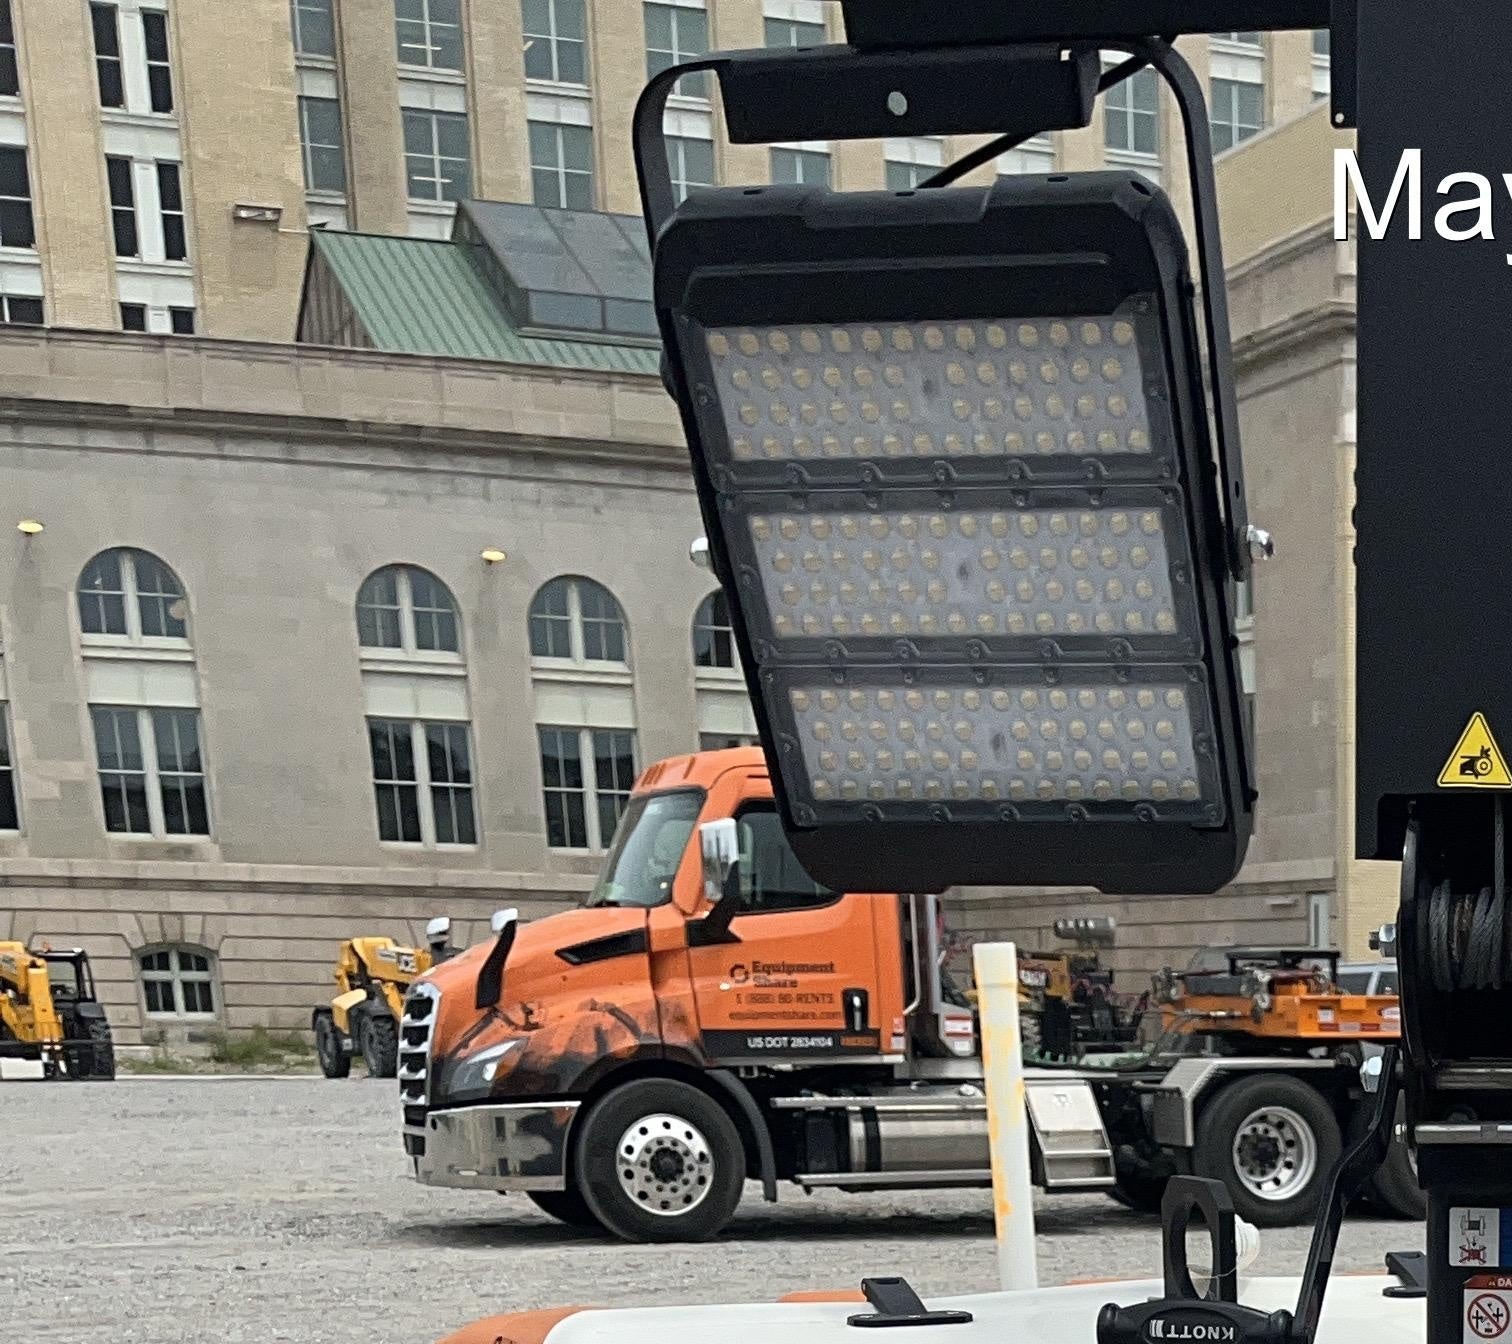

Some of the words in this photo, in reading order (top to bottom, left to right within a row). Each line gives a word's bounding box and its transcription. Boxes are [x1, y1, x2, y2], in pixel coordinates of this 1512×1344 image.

[752, 961, 835, 975] Equipment
[753, 975, 798, 988] Share
[764, 1037, 788, 1049] DOT
[1166, 1325, 1235, 1341] KNOTT
